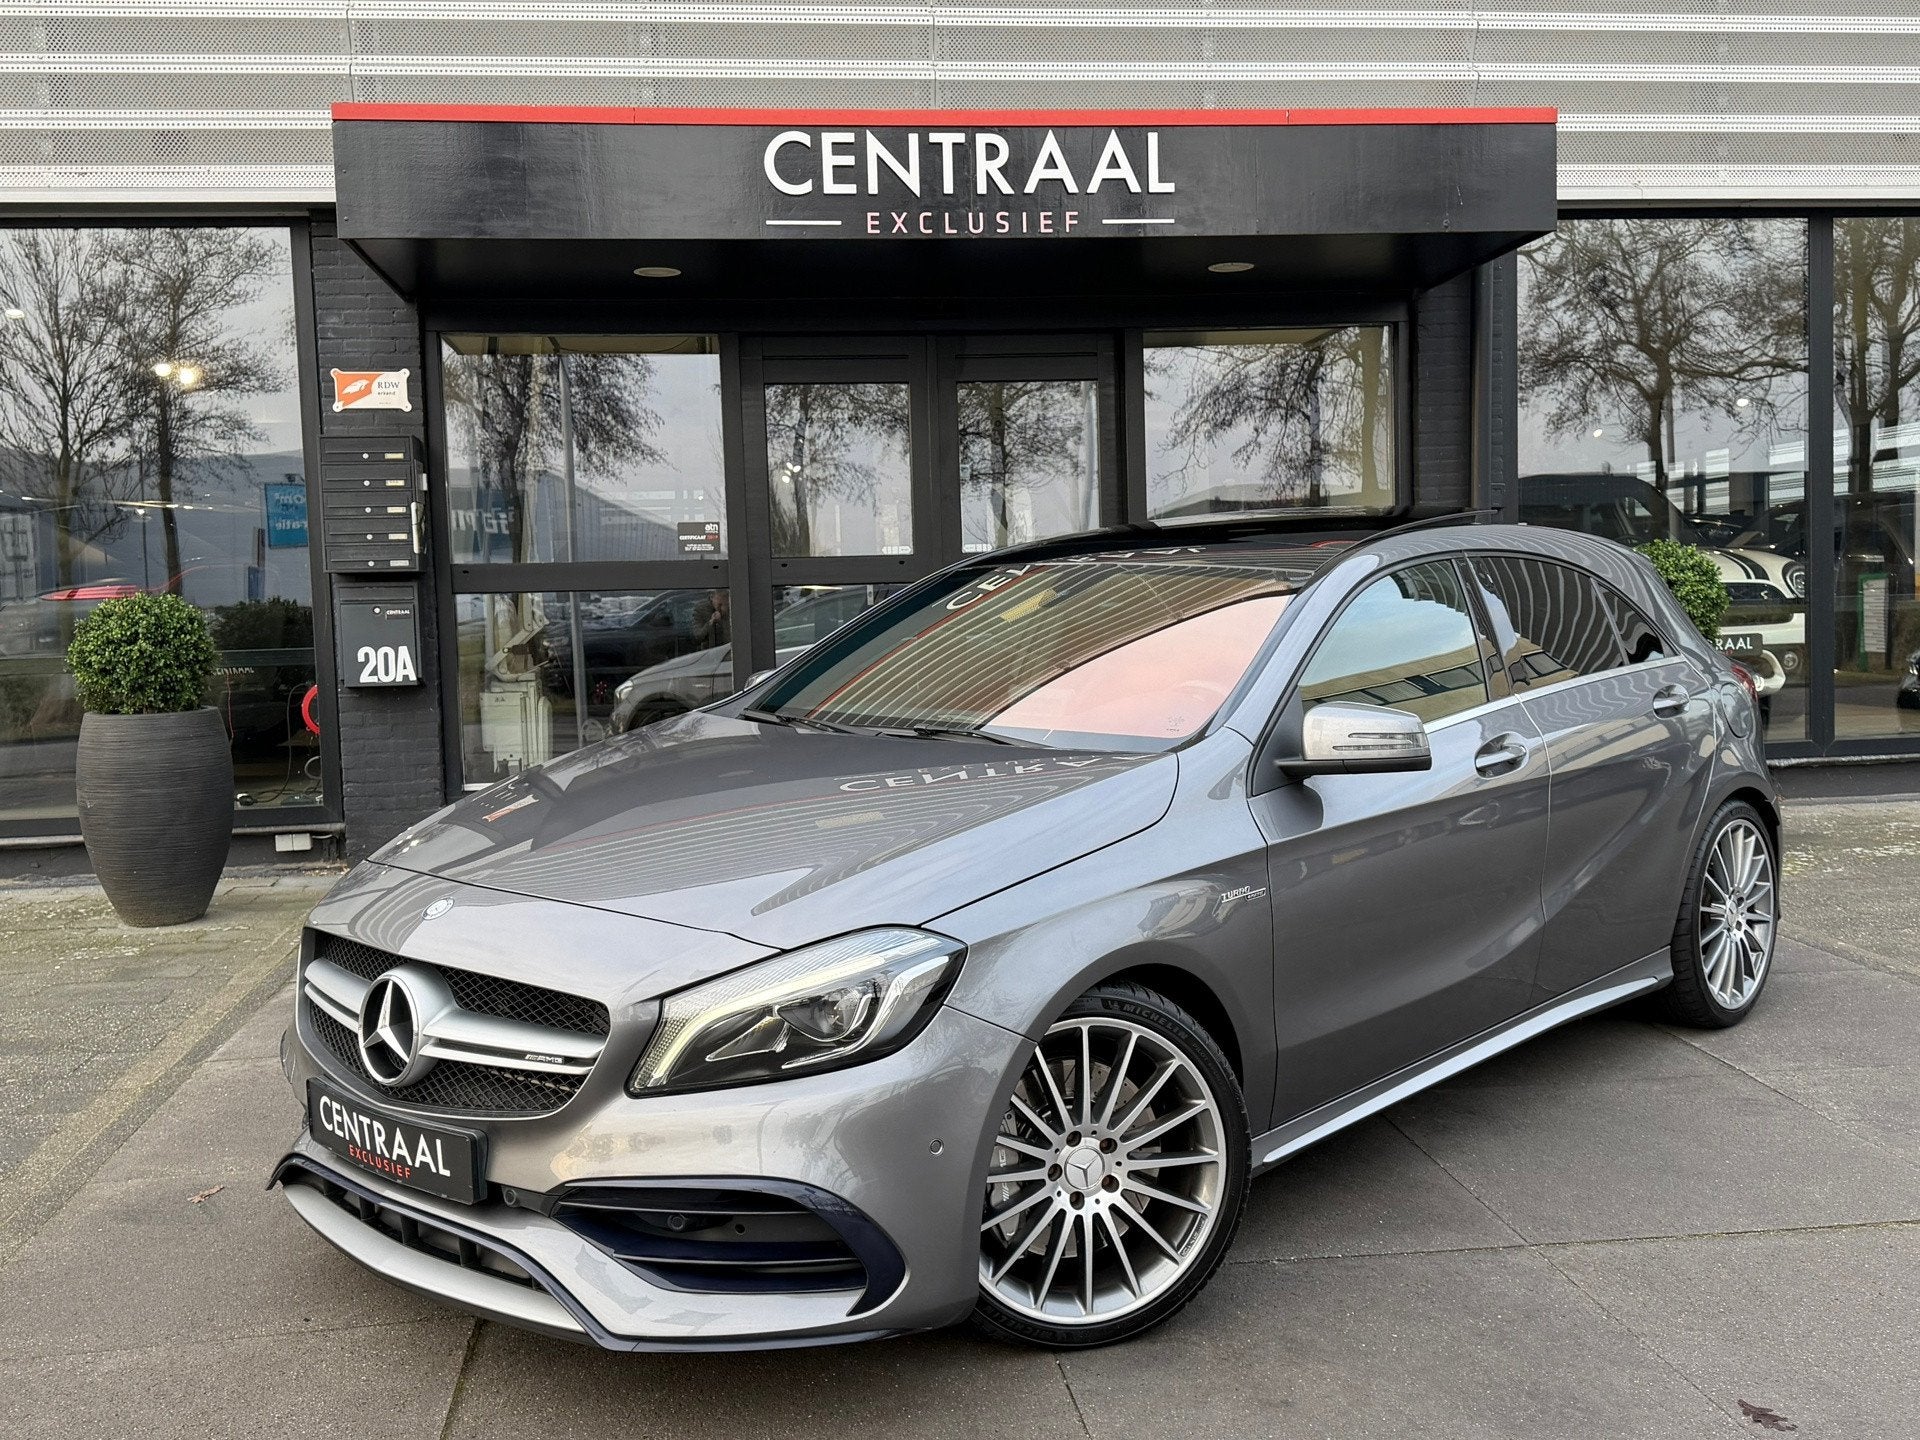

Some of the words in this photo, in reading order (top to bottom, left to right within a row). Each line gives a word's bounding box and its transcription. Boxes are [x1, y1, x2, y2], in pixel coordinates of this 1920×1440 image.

[763, 129, 1176, 198] CENTRAAL
[867, 211, 1079, 235] EXCLUSIEF
[377, 381, 400, 389] RDW
[1712, 636, 1754, 651] RAAL
[357, 646, 417, 683] 20A
[1122, 1003, 1189, 1040] MICHELIN
[319, 1095, 451, 1178] CENTRAAL
[348, 1143, 412, 1179] EXCLUSIEF
